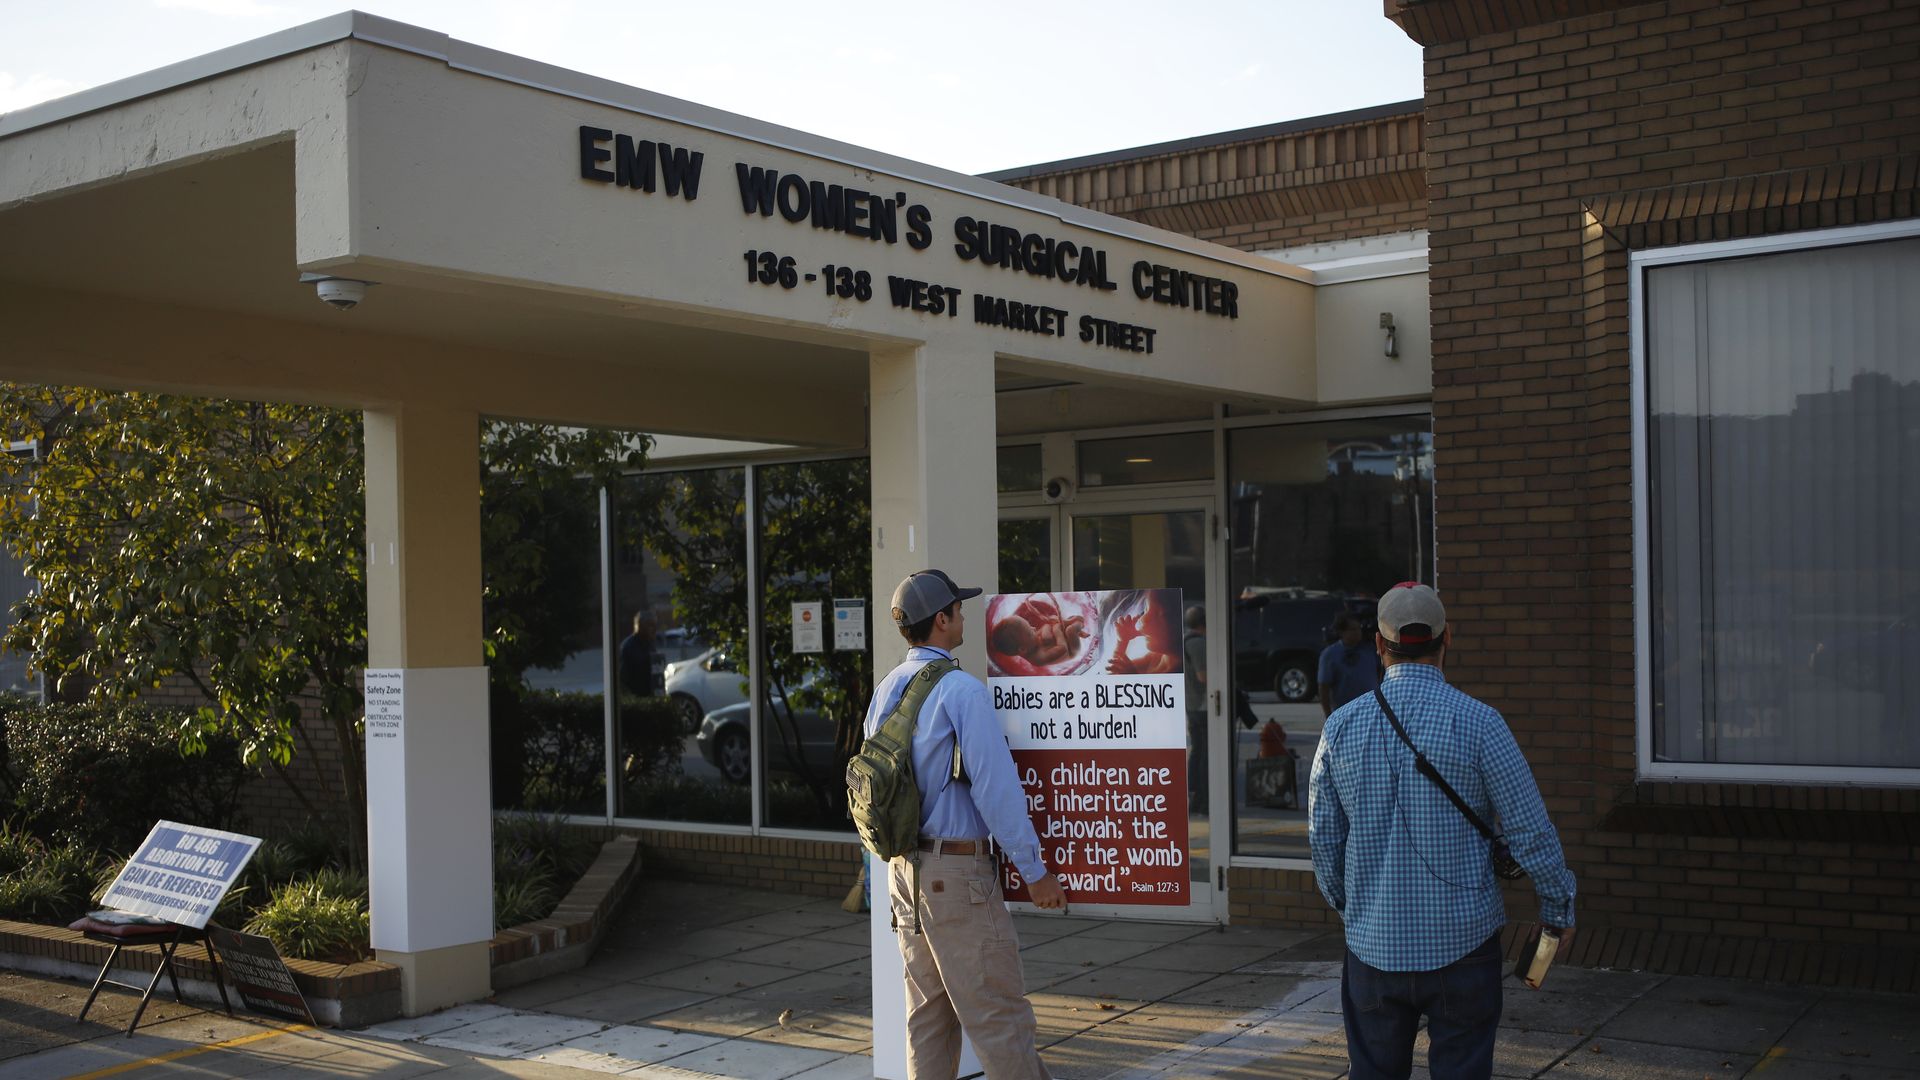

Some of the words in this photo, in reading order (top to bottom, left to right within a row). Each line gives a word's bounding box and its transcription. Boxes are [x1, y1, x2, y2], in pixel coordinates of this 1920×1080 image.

[579, 125, 704, 202] EMW
[735, 162, 932, 250] WOMEN'S
[954, 216, 1117, 290] SURGICAL
[1132, 260, 1239, 319] CENTER
[888, 275, 961, 317] WEST
[973, 293, 1069, 337] MARKET
[1079, 315, 1156, 354] STREET
[367, 686, 385, 695] Safety
[386, 686, 401, 694] Zone
[994, 685, 1043, 710] Babies
[1049, 691, 1075, 709] are
[1081, 691, 1089, 709] a
[1095, 683, 1175, 709] BLESSING
[1031, 718, 1057, 740] not
[1063, 722, 1072, 739] a
[1078, 714, 1137, 740] burden!
[1051, 760, 1130, 786] children
[1137, 767, 1171, 786] are
[1054, 789, 1167, 813] inheritance
[1041, 815, 1123, 840] Jehovah;
[1132, 815, 1168, 839] the
[176, 834, 196, 850] RU
[194, 837, 221, 855] 486
[1055, 841, 1076, 865] of
[1084, 842, 1119, 865] the
[1127, 841, 1183, 866] womb
[144, 847, 206, 873] ABORTION
[200, 858, 230, 877] PILL
[123, 866, 152, 885] CAN
[146, 872, 165, 889] BE
[163, 875, 222, 901] REVERSED
[1005, 867, 1020, 890] is
[1131, 882, 1154, 892] Psalm
[1156, 882, 1180, 893] 127:3
